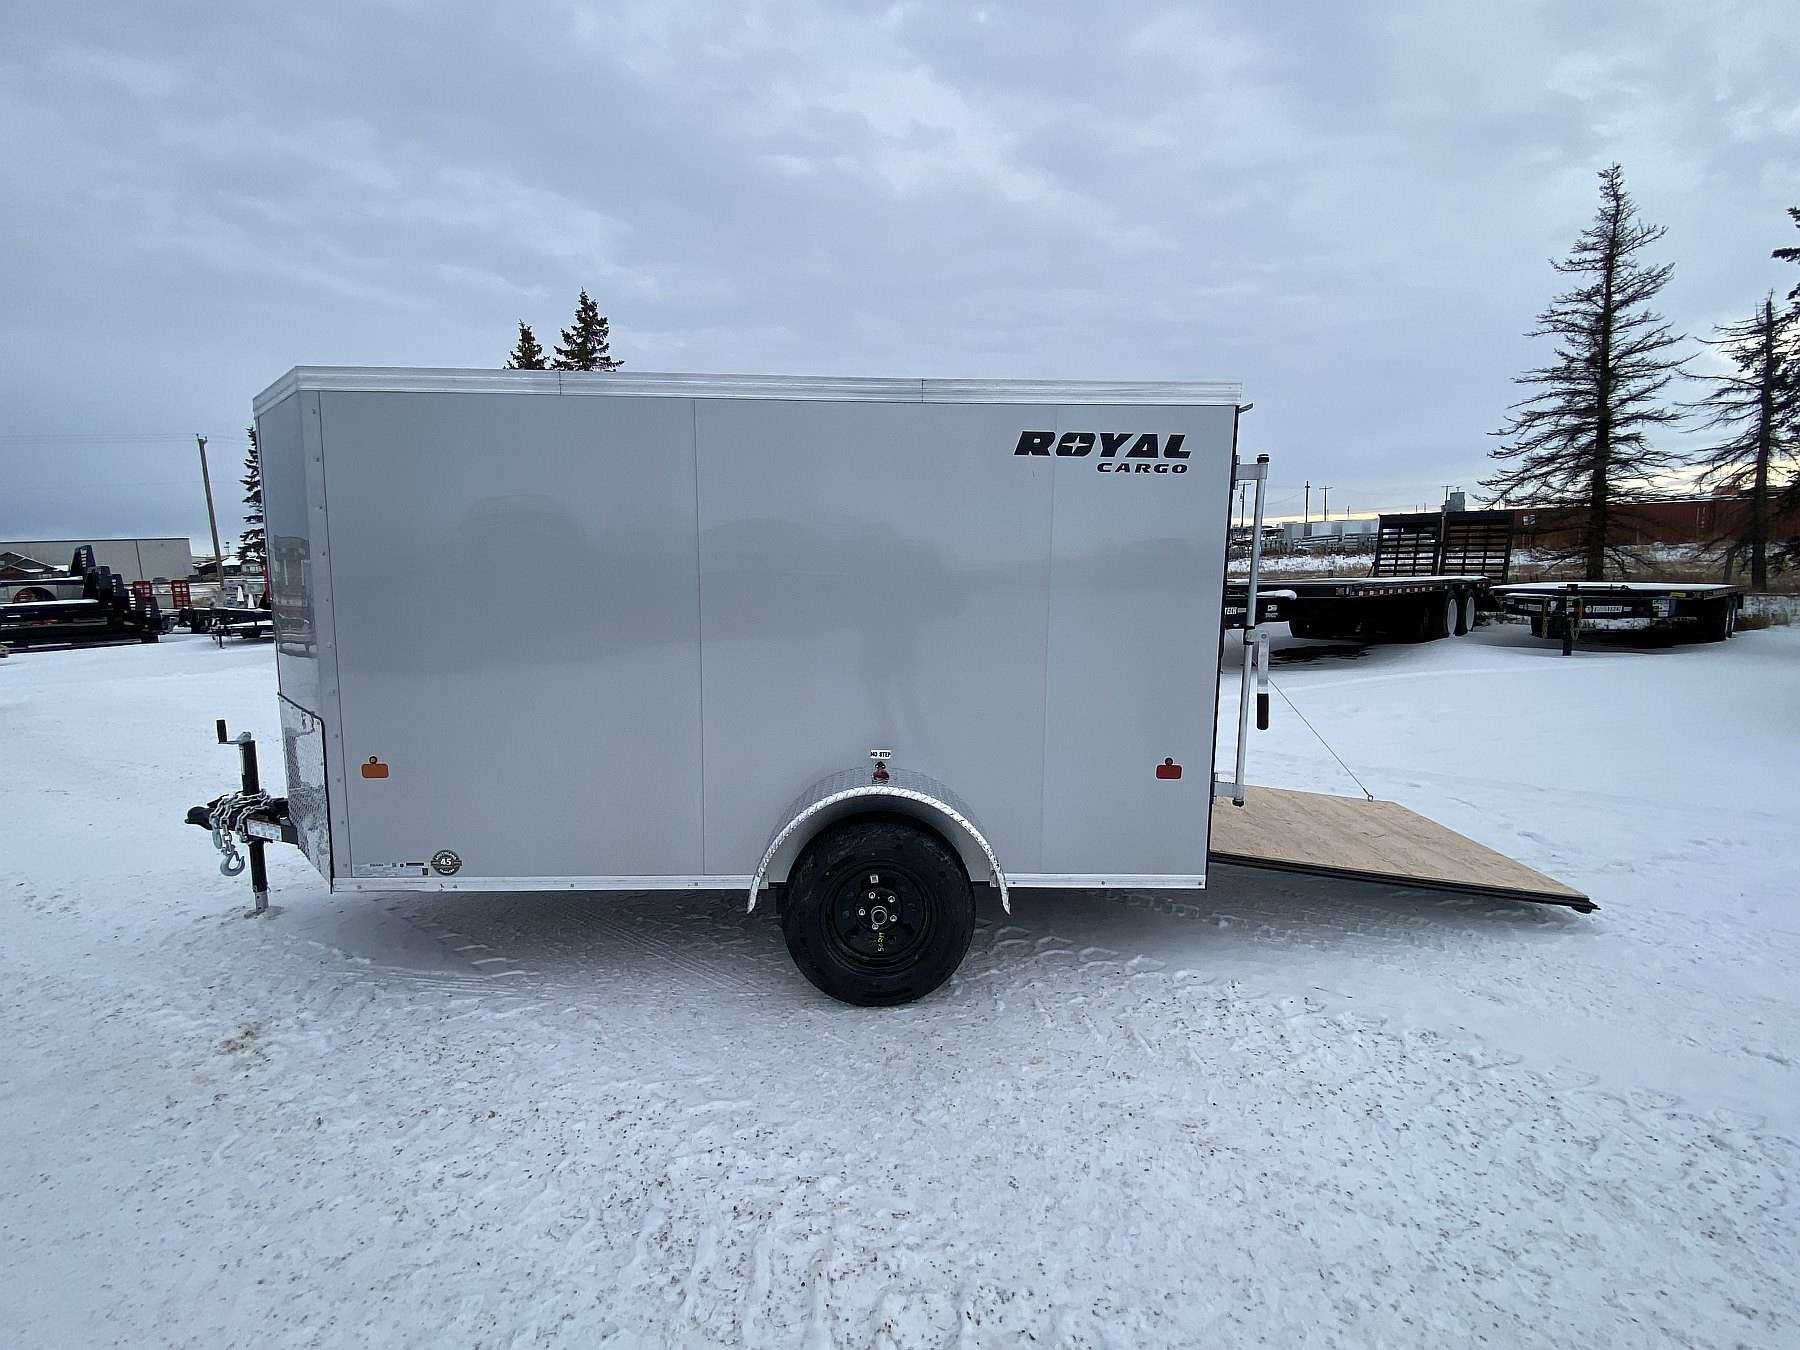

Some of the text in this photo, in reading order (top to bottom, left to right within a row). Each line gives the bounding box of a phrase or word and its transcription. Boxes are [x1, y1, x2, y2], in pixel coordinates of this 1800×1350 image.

[1013, 430, 1192, 459] ROYAL
[1097, 462, 1188, 474] CARGO
[440, 858, 452, 866] 45
